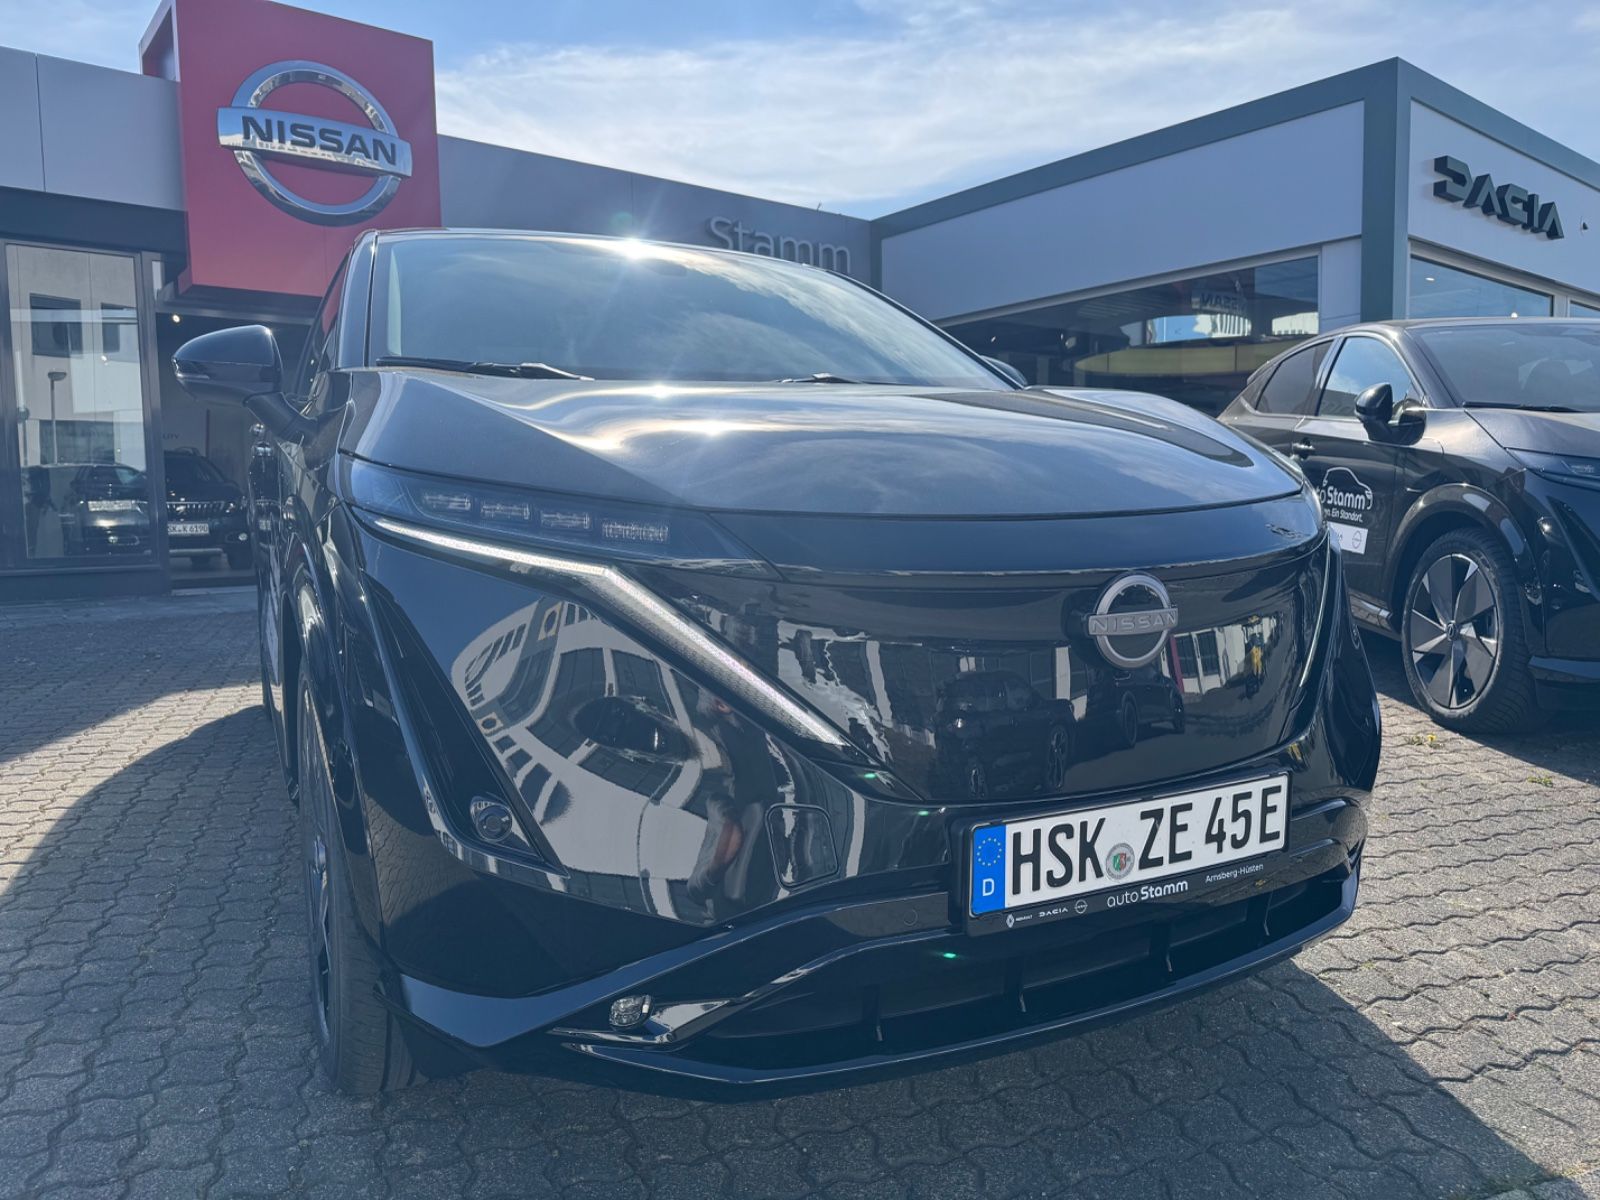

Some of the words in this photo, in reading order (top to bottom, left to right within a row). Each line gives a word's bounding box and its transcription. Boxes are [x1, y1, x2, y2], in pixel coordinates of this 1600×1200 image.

[241, 115, 397, 166] NISSAN
[1433, 155, 1564, 239] DACIA
[708, 216, 850, 274] Stamm
[1092, 611, 1177, 633] NISSAN
[1011, 817, 1106, 896] HSK
[1138, 802, 1193, 870] ZE
[981, 878, 995, 897] D
[1038, 907, 1068, 917] DACIA
